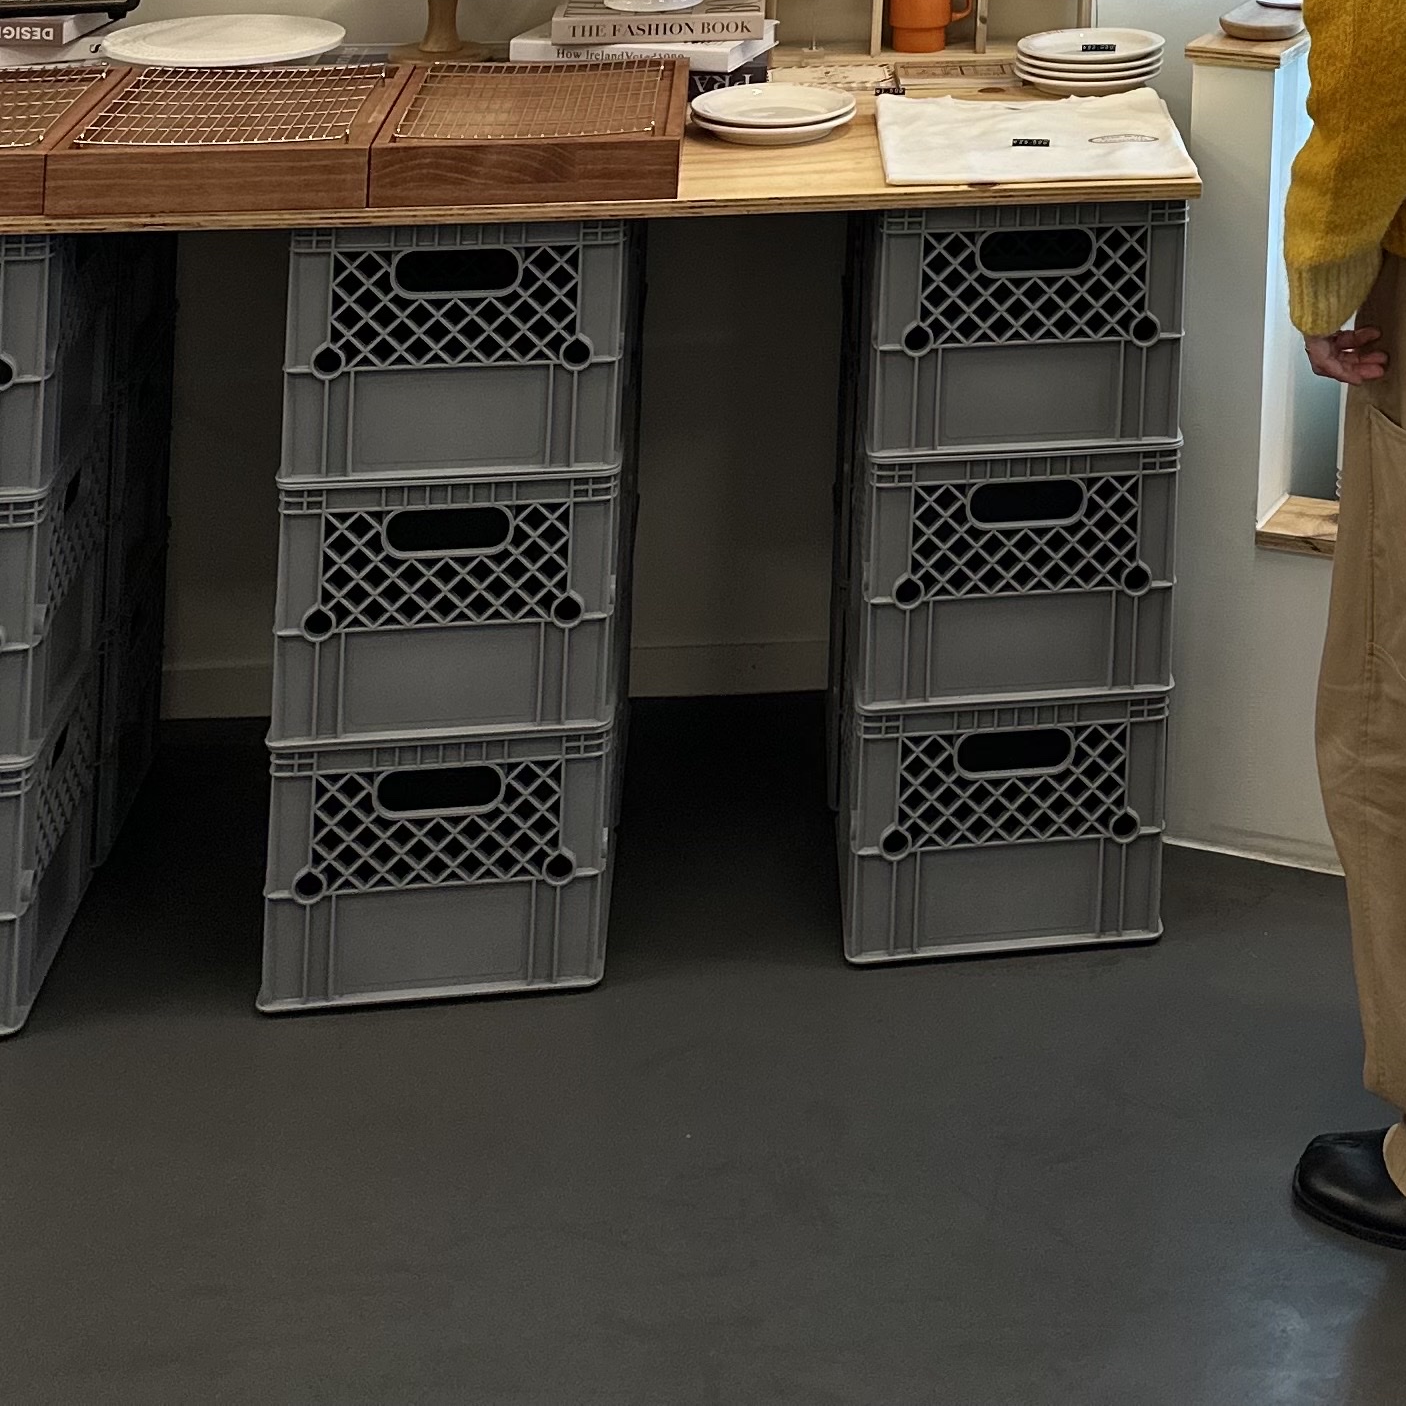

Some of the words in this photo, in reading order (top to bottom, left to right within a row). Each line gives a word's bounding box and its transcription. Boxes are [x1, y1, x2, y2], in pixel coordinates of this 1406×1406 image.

[0, 26, 54, 40] DESIG
[568, 24, 607, 37] THE
[612, 22, 696, 37] FASHION
[701, 21, 752, 34] BOOK
[556, 49, 583, 59] How
